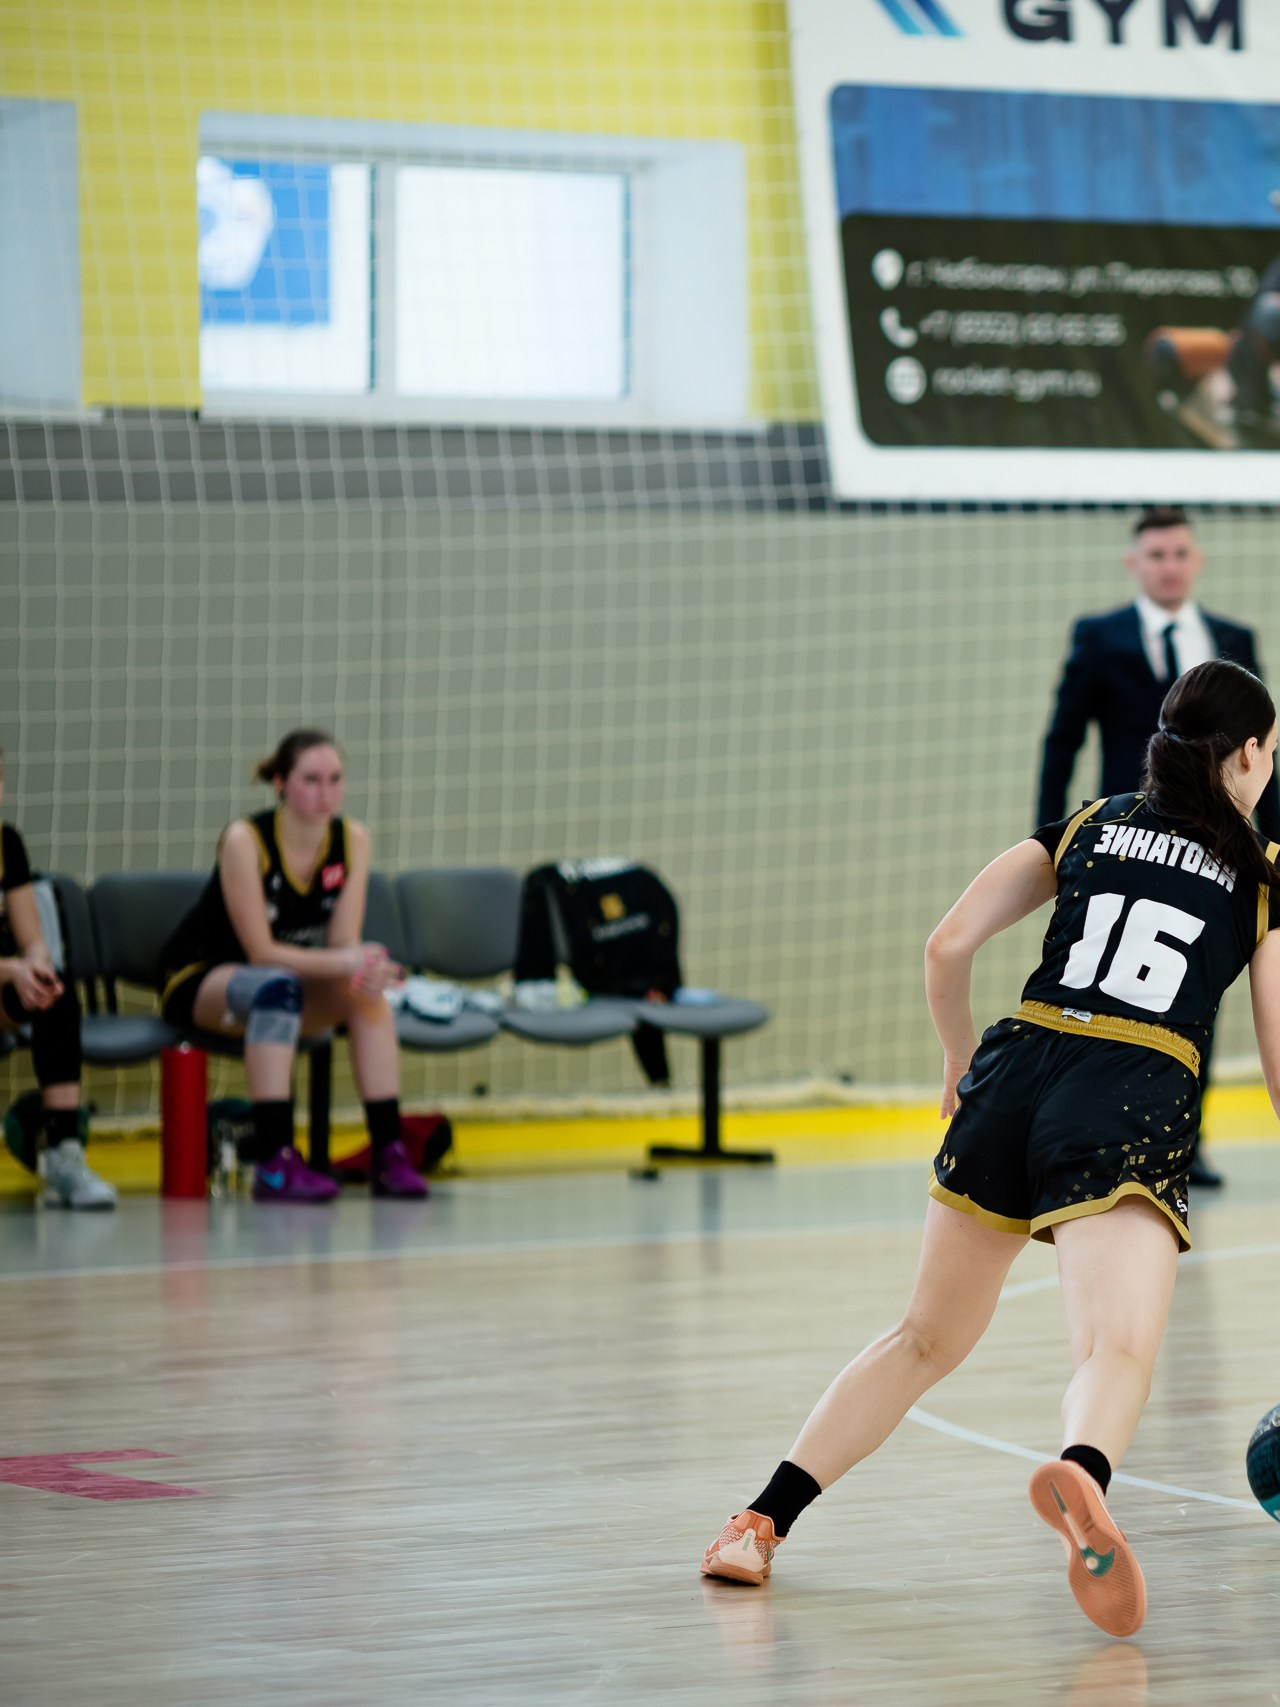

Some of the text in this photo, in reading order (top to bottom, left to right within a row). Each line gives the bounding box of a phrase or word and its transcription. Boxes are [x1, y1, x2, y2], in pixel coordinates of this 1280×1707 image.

[1001, 0, 1241, 51] GYM
[928, 258, 1069, 294] Чебоксары,
[933, 364, 1100, 401] rocket-gym.ru
[1059, 892, 1206, 1013] 16
